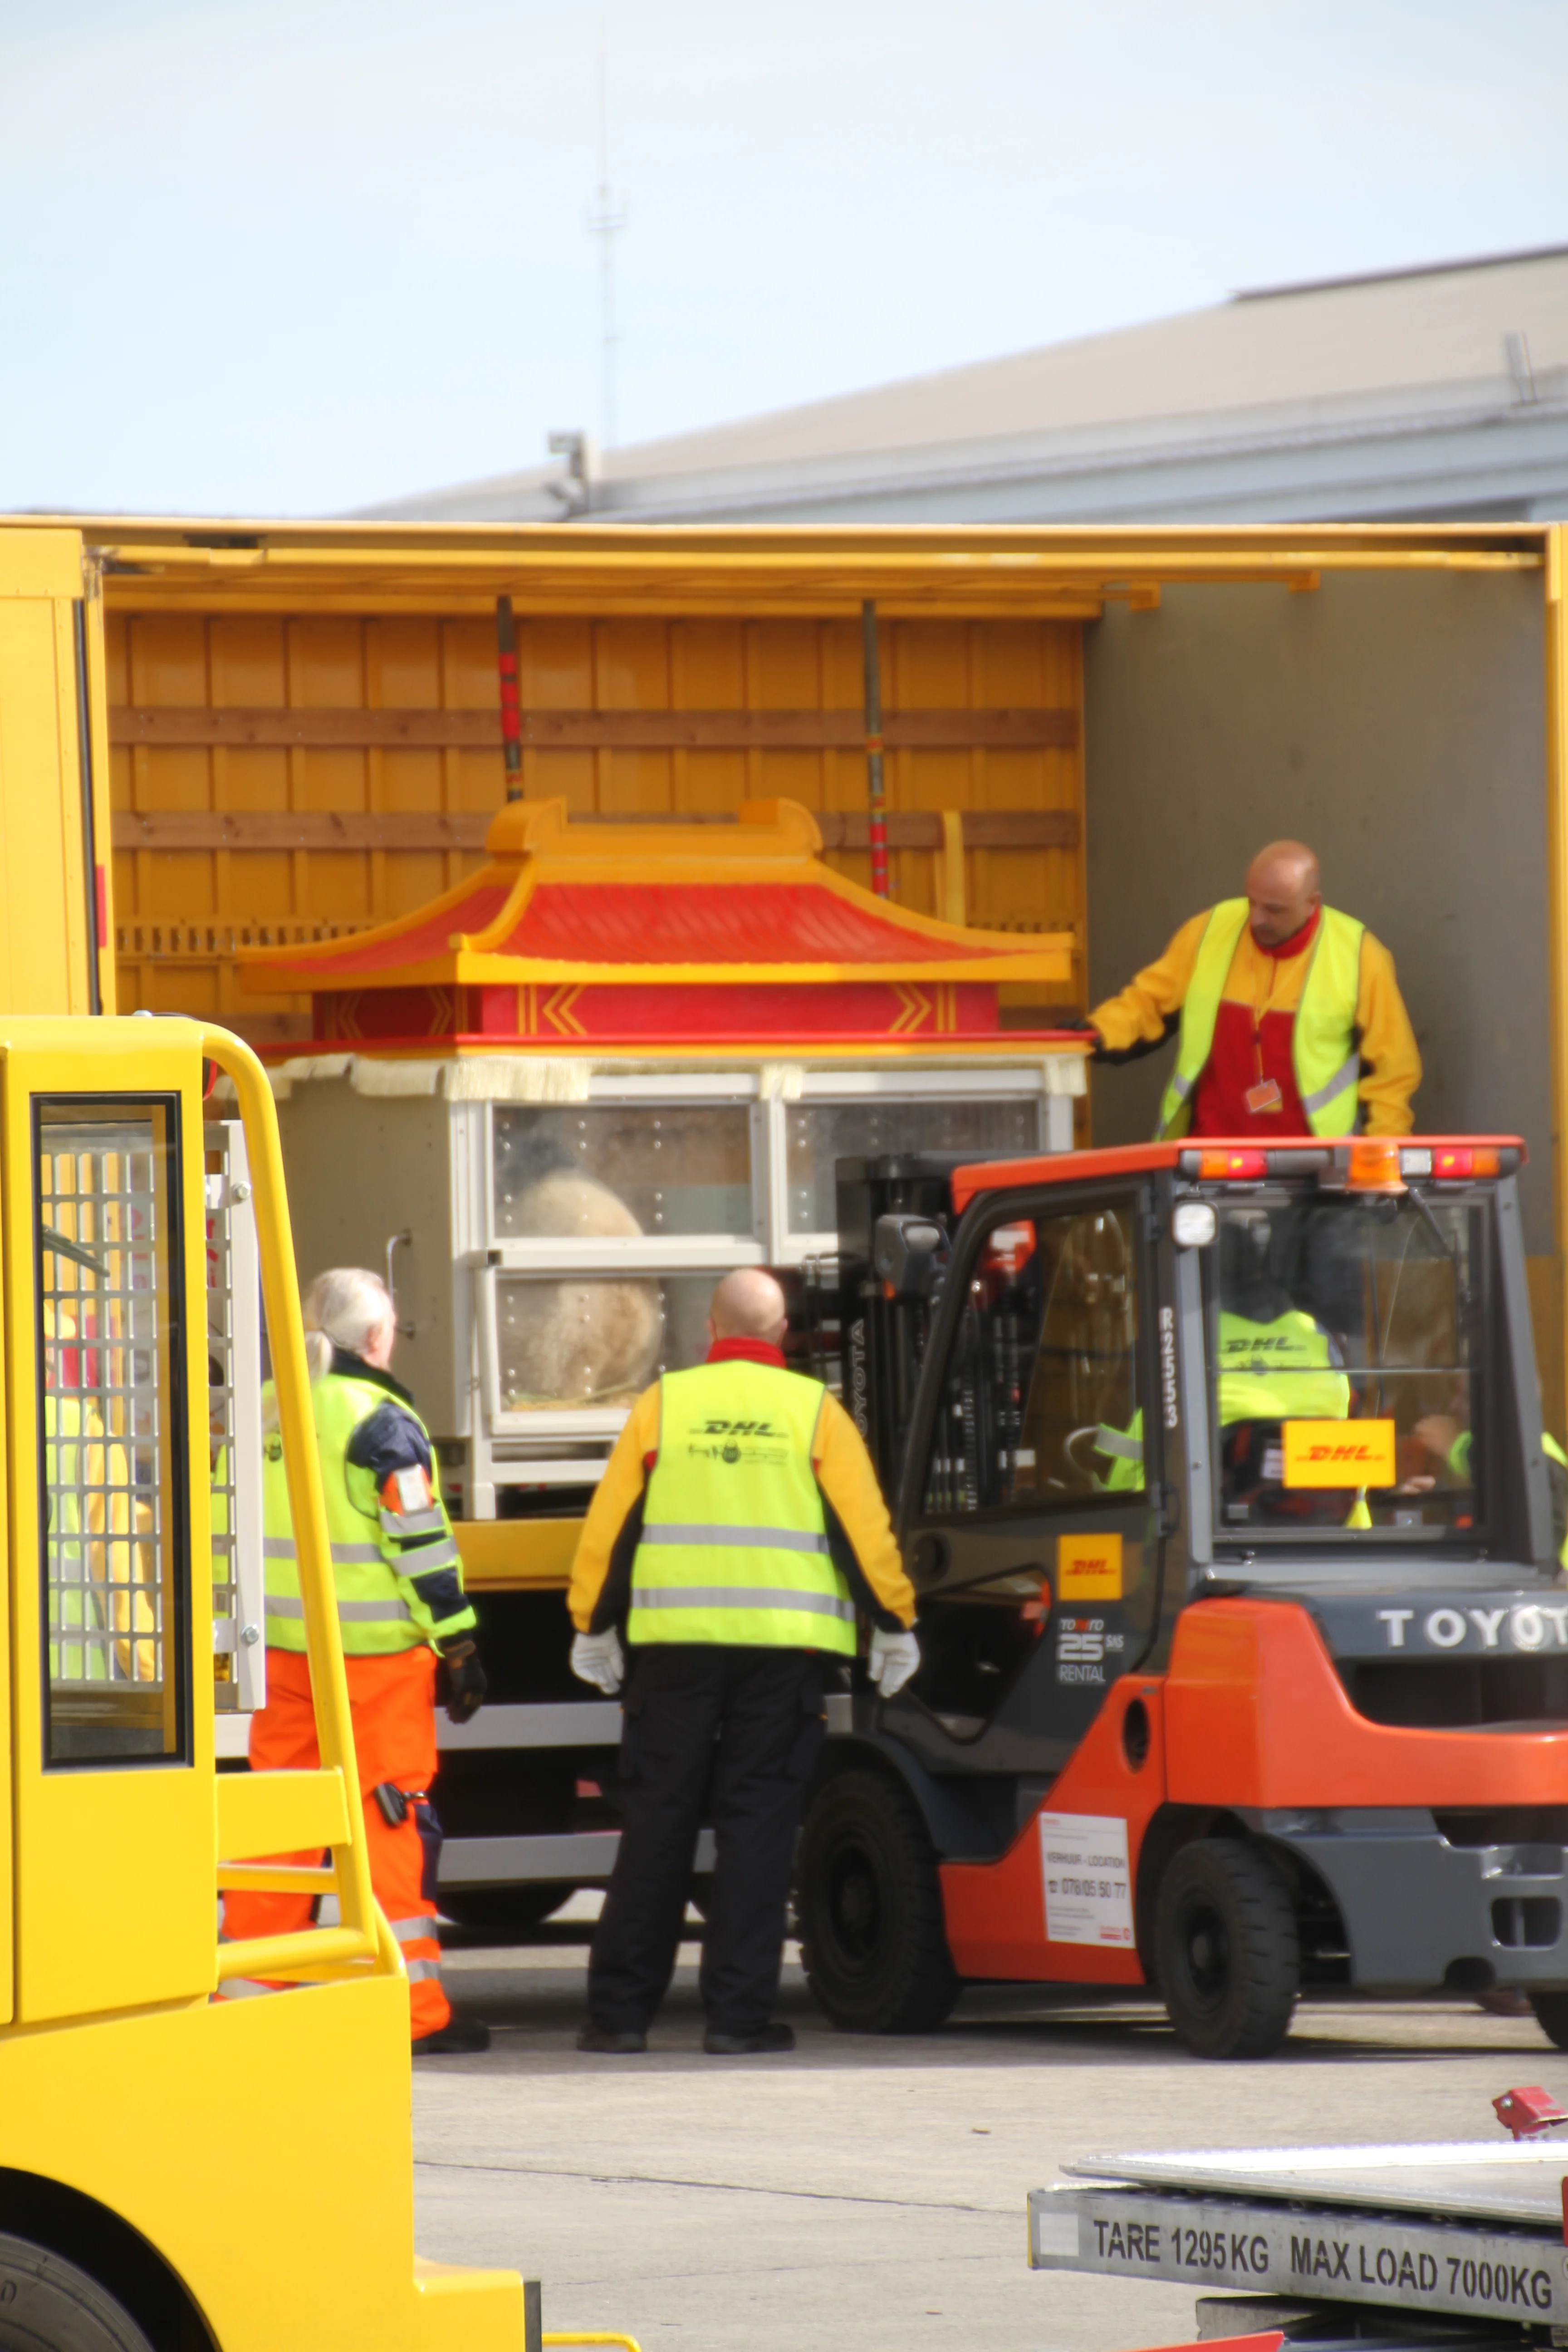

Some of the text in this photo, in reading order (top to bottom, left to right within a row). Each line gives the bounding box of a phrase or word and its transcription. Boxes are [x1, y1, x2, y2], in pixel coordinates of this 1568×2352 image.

[1226, 1337, 1294, 1352] DHL
[1159, 1307, 1177, 1428] R25553
[851, 1318, 867, 1442] OYOTA
[705, 1420, 774, 1436] DHL
[1309, 1445, 1372, 1460] DHL
[1073, 1559, 1108, 1575] DHL
[1057, 1633, 1103, 1661] 25
[1059, 1665, 1106, 1681] RENTAL
[1099, 1881, 1111, 1897] 50
[1114, 1882, 1126, 1899] 77
[1094, 2220, 1161, 2262] TARE
[1291, 2236, 1351, 2281] MAX
[1360, 2245, 1438, 2291] LOAD
[1447, 2257, 1552, 2309] 7000KG
